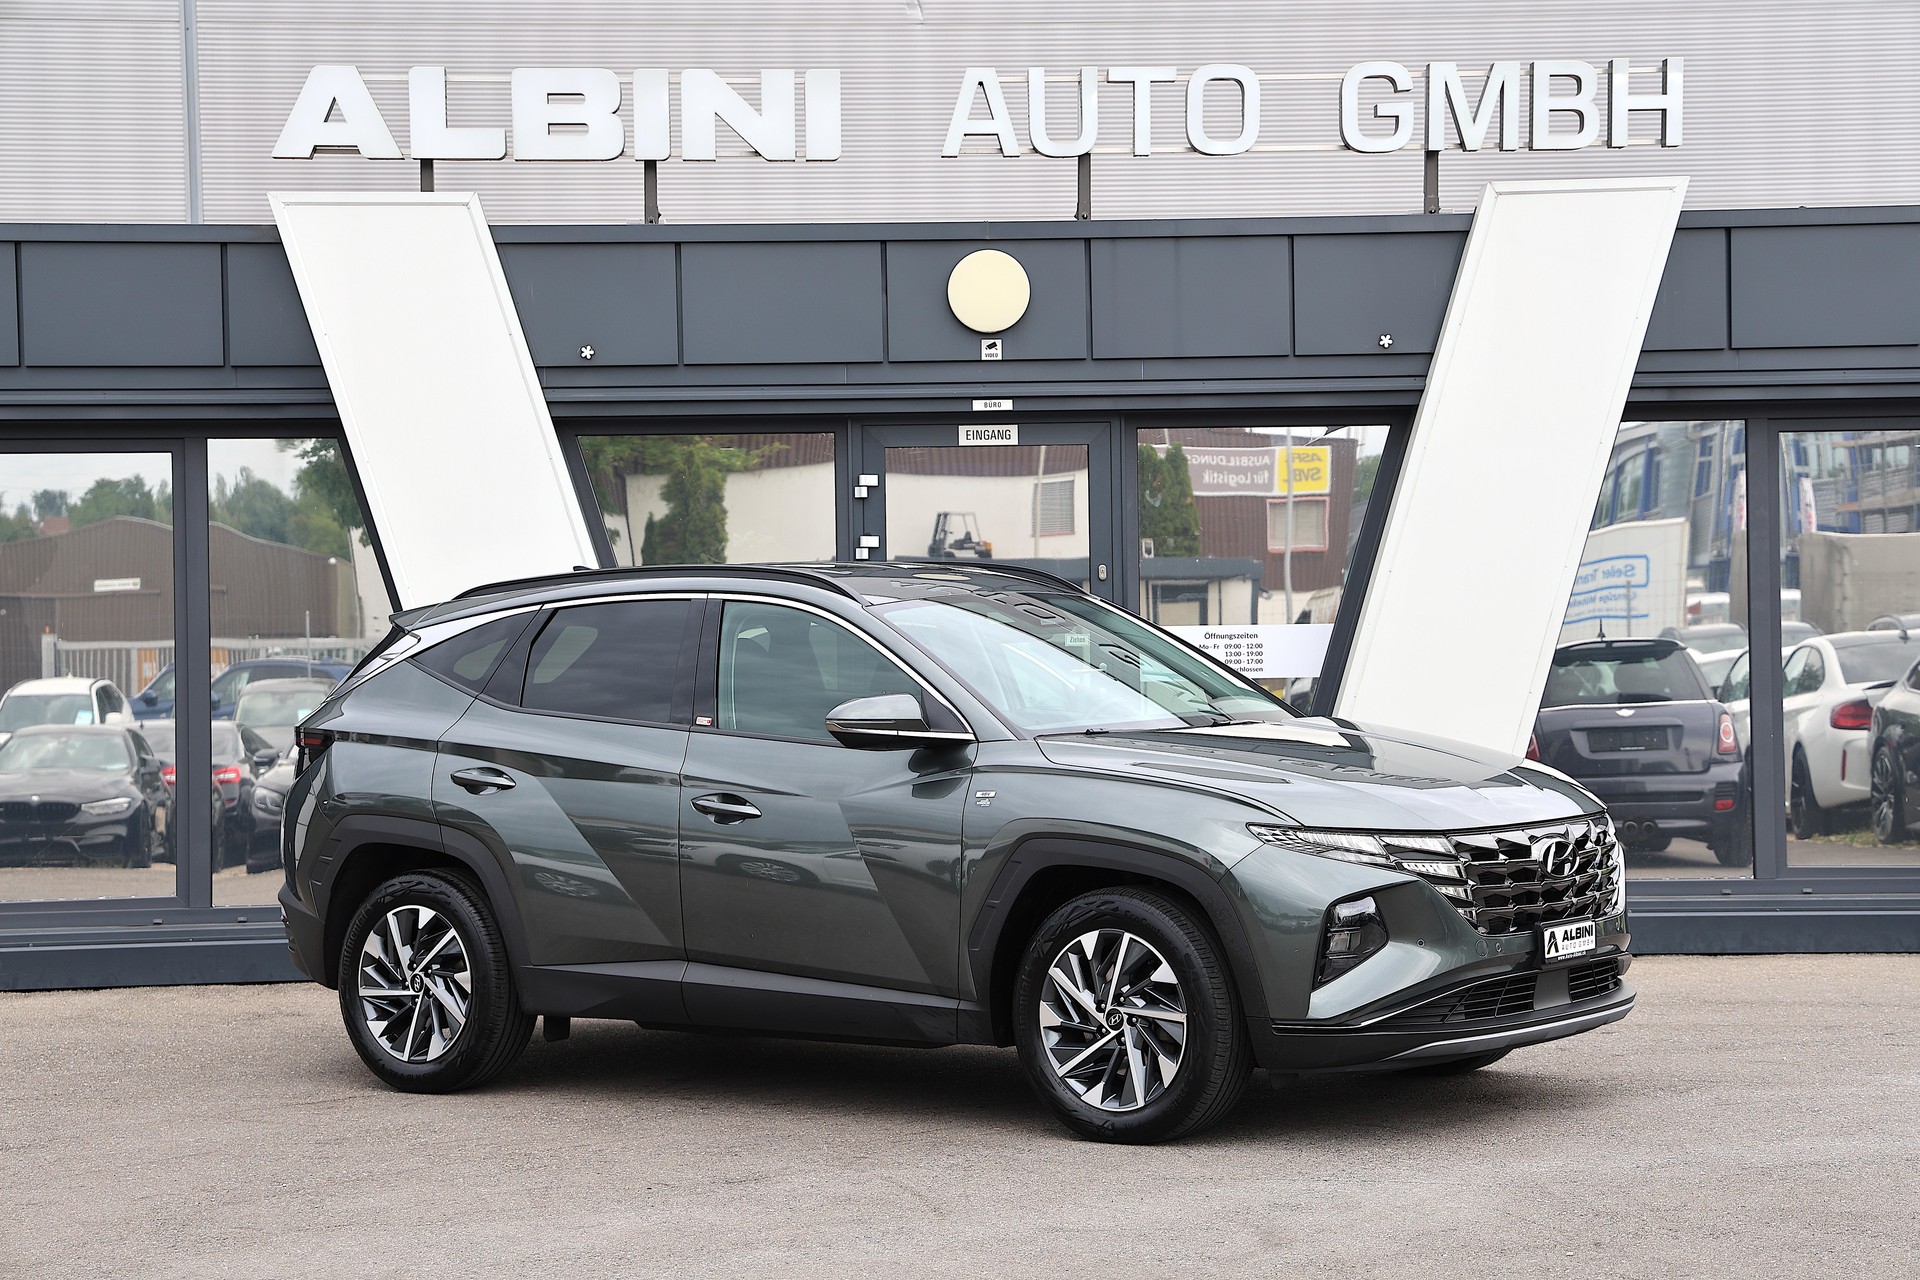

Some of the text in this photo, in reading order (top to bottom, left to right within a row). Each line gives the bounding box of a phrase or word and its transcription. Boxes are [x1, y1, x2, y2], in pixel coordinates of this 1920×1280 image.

[271, 56, 1684, 161] ALBINI AUTO GMBH
[983, 401, 1002, 409] BÜRO
[965, 429, 1012, 441] EINGANG
[1203, 631, 1259, 641] Öffnungszeiten
[1562, 924, 1594, 943] ALBINI
[1562, 941, 1577, 950] AUTO
